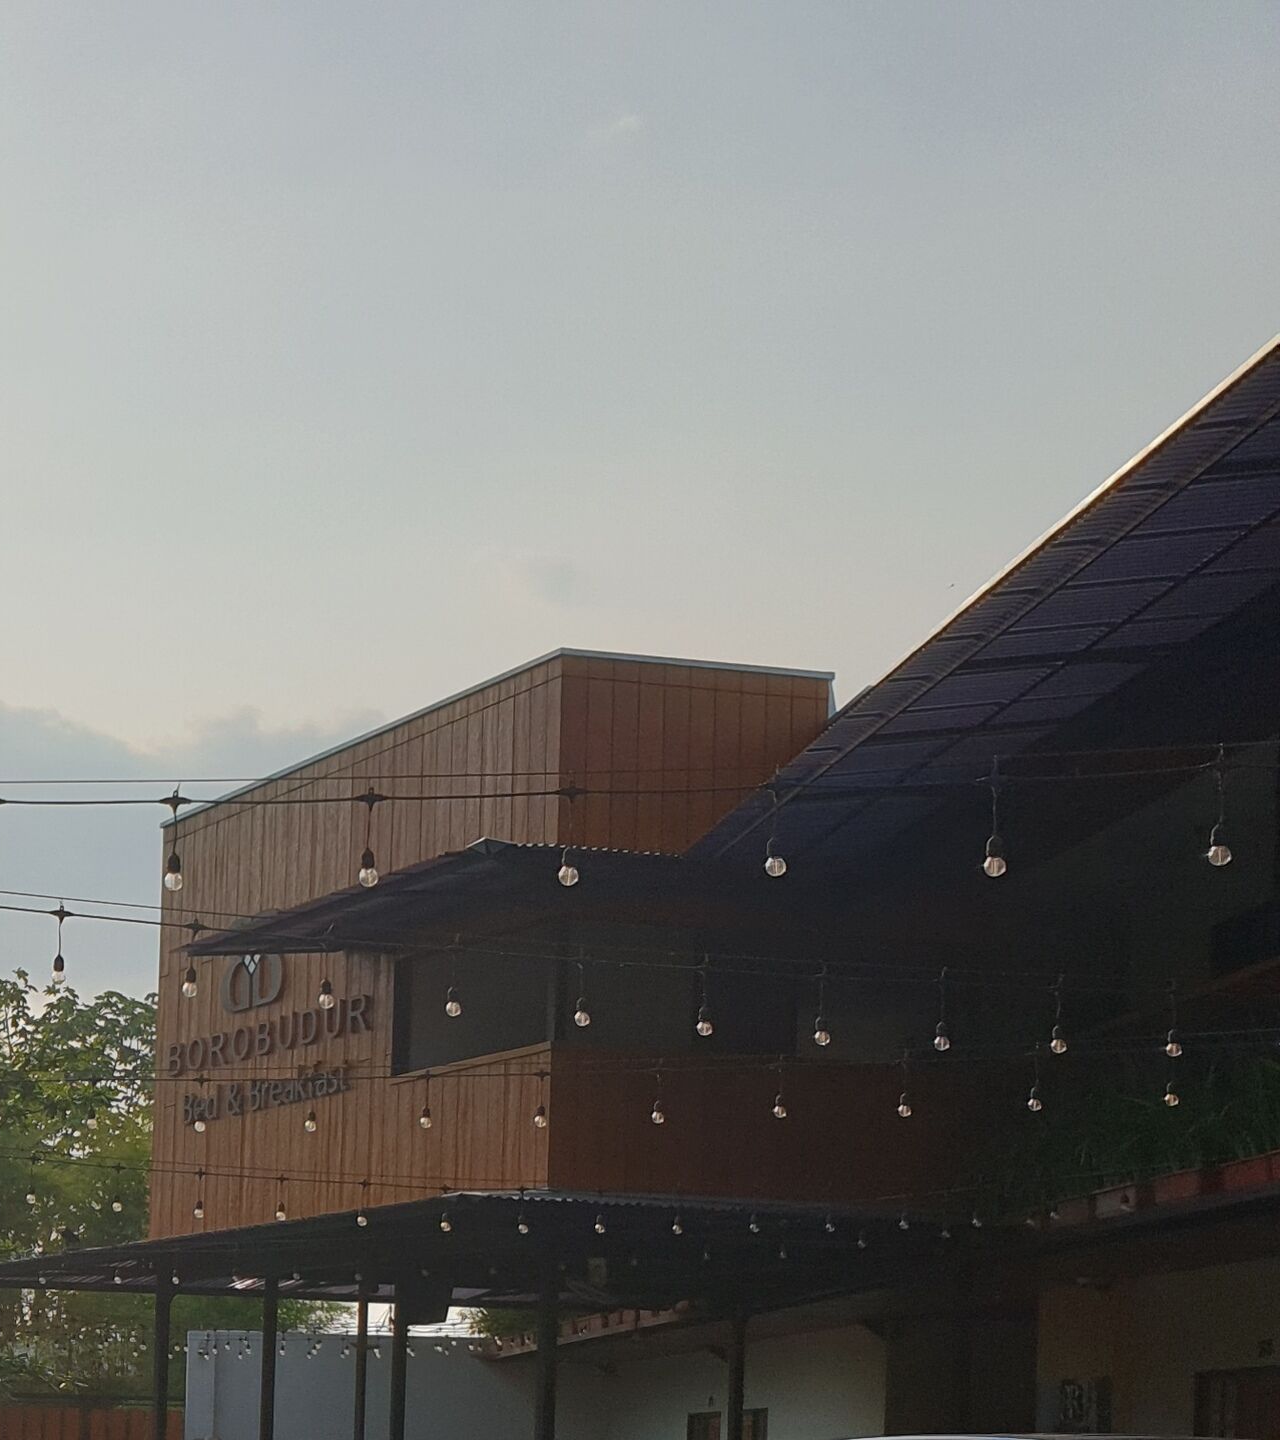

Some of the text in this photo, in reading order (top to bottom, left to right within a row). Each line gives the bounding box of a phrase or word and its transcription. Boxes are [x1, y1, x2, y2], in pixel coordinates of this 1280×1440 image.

[167, 994, 372, 1077] BOROBUDUR
[183, 1063, 350, 1126] Bed & Breakfast
